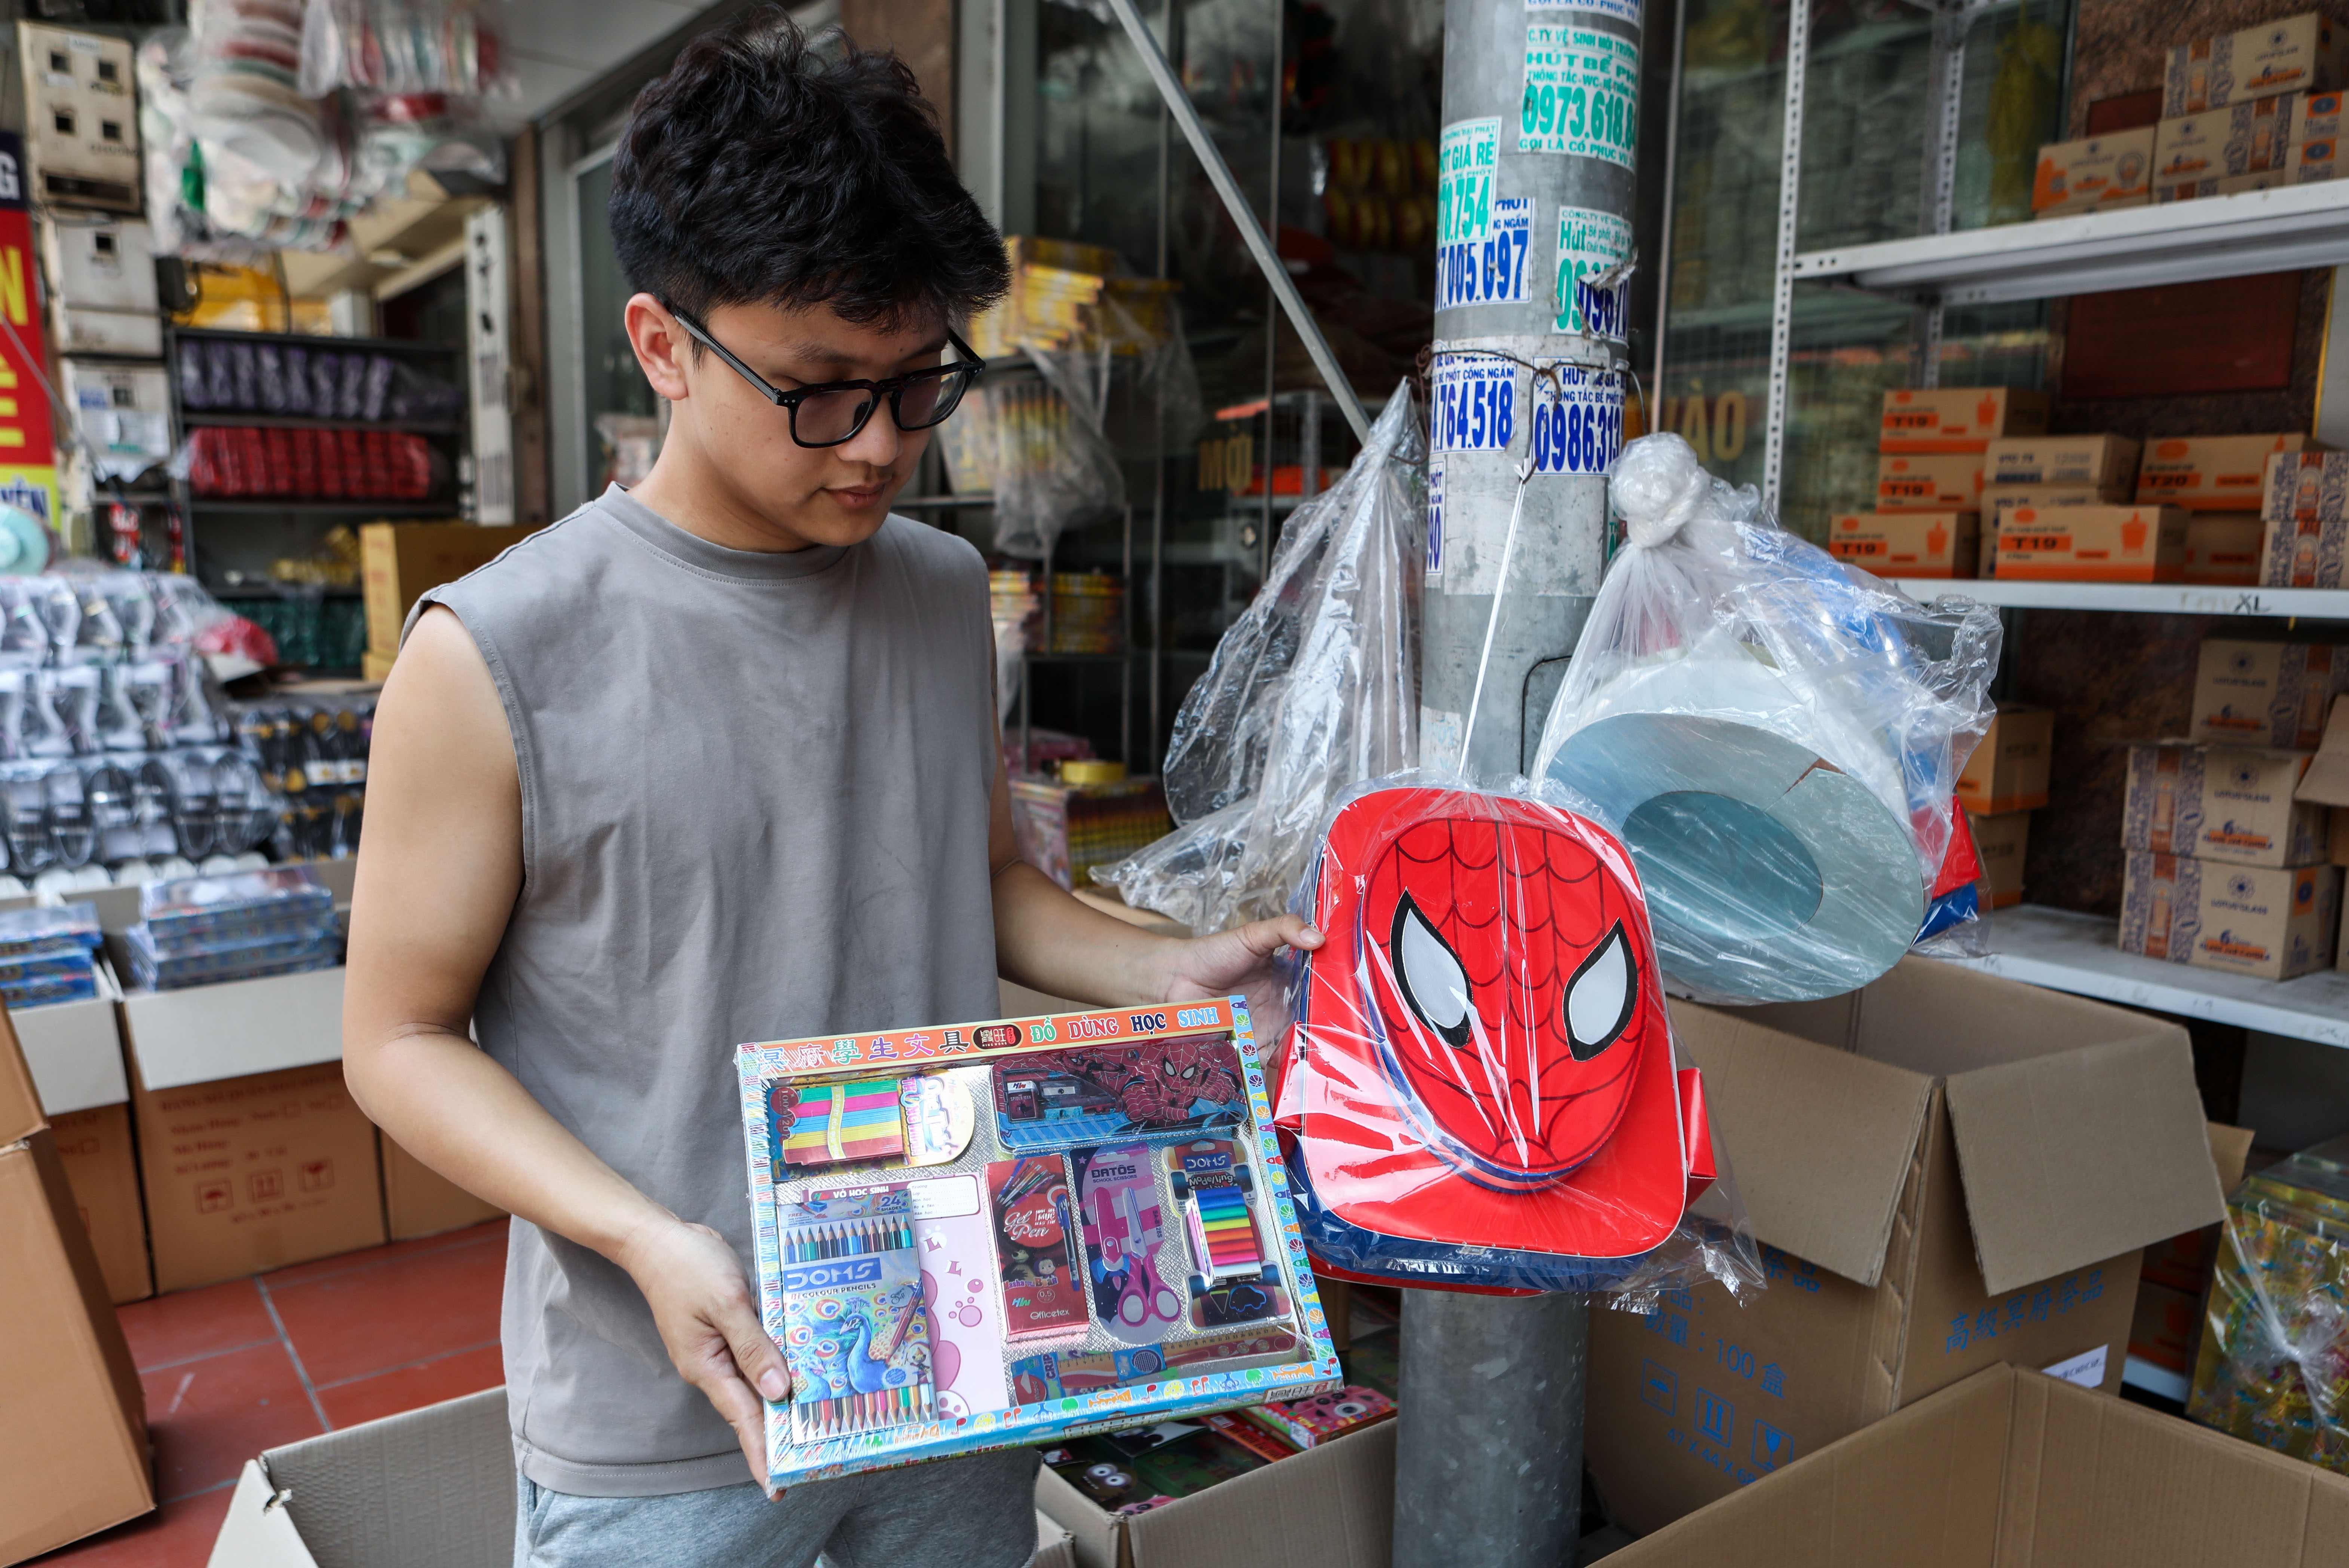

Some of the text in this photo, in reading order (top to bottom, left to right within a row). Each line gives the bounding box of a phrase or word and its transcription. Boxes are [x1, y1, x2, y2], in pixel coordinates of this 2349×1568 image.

[1573, 31, 1596, 47] SINH
[1527, 49, 1579, 67] HÚT
[1583, 54, 1613, 74] BỂ
[1452, 134, 1494, 170] GIÁ RẺ
[1548, 137, 1564, 150] LÀ
[1569, 140, 1586, 152] CÓ
[1562, 209, 1587, 220] CÔNG
[1560, 221, 1586, 251] Hút
[1463, 365, 1485, 380] CỐNG
[1889, 484, 1924, 496] T19
[1839, 543, 1875, 555] T19
[2010, 536, 2057, 550] T19
[1030, 1016, 1057, 1043] ĐỒ
[1068, 1016, 1119, 1040] DÙNG
[1130, 1013, 1167, 1036] HỌC
[1177, 1007, 1219, 1027] SINH
[1186, 1155, 1226, 1169] DOMS
[1188, 1174, 1234, 1186] Modelling
[870, 1185, 889, 1194] SINH
[881, 1196, 902, 1207] 24
[1004, 1210, 1033, 1232] Gel
[1010, 1223, 1050, 1241] Pen
[787, 1261, 875, 1290] DOMS
[802, 1289, 838, 1299] COLOUR
[841, 1283, 876, 1293] PENCILS
[1945, 1273, 2104, 1354] 高級冥府祭品
[1717, 1338, 1787, 1400] 100 盒
[1666, 1427, 1684, 1448] 47
[1701, 1447, 1720, 1470] 44
